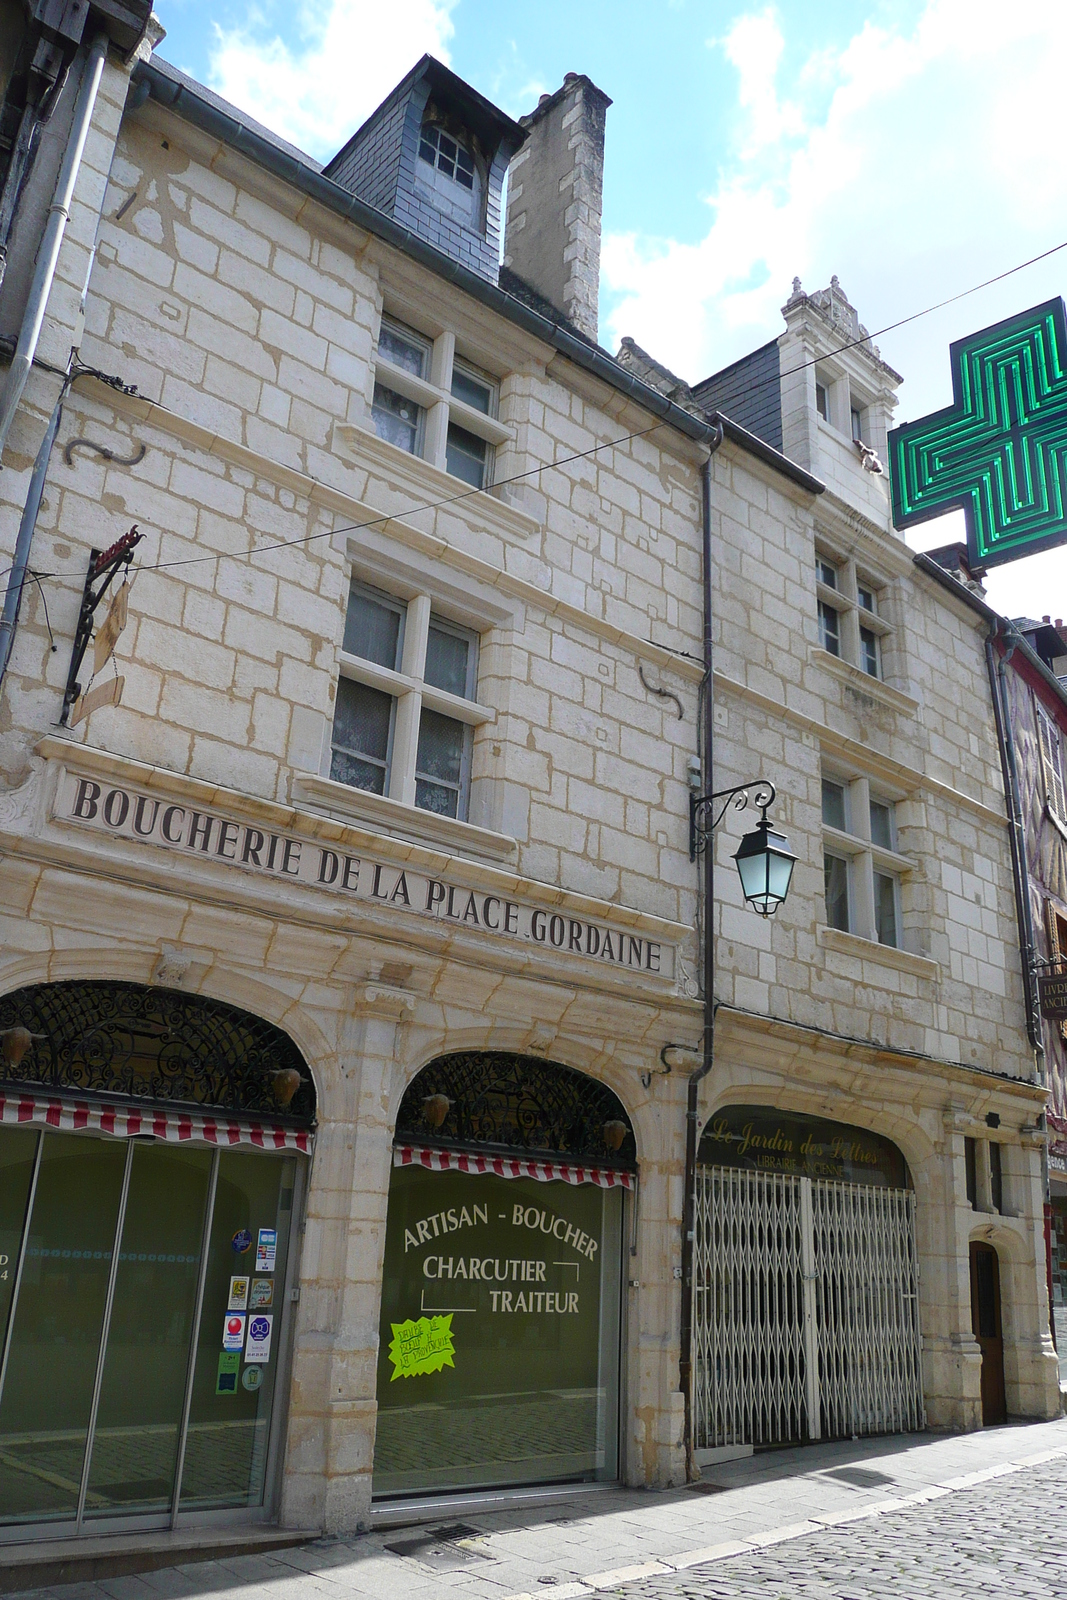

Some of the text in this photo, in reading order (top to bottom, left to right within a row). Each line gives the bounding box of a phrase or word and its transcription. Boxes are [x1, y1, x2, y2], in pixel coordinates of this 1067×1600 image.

[70, 778, 662, 973] BOUCHERIE DE LA PLACE GORDAINE
[713, 1117, 878, 1165] Le Jardin des Lettres
[757, 1154, 845, 1178] LIBRAIRIE ANCIENNE
[404, 1203, 489, 1253] ARTISAN
[512, 1203, 599, 1262] BOUCHER
[422, 1255, 547, 1282] CHARCUTIER
[489, 1290, 580, 1314] TRAITEUR
